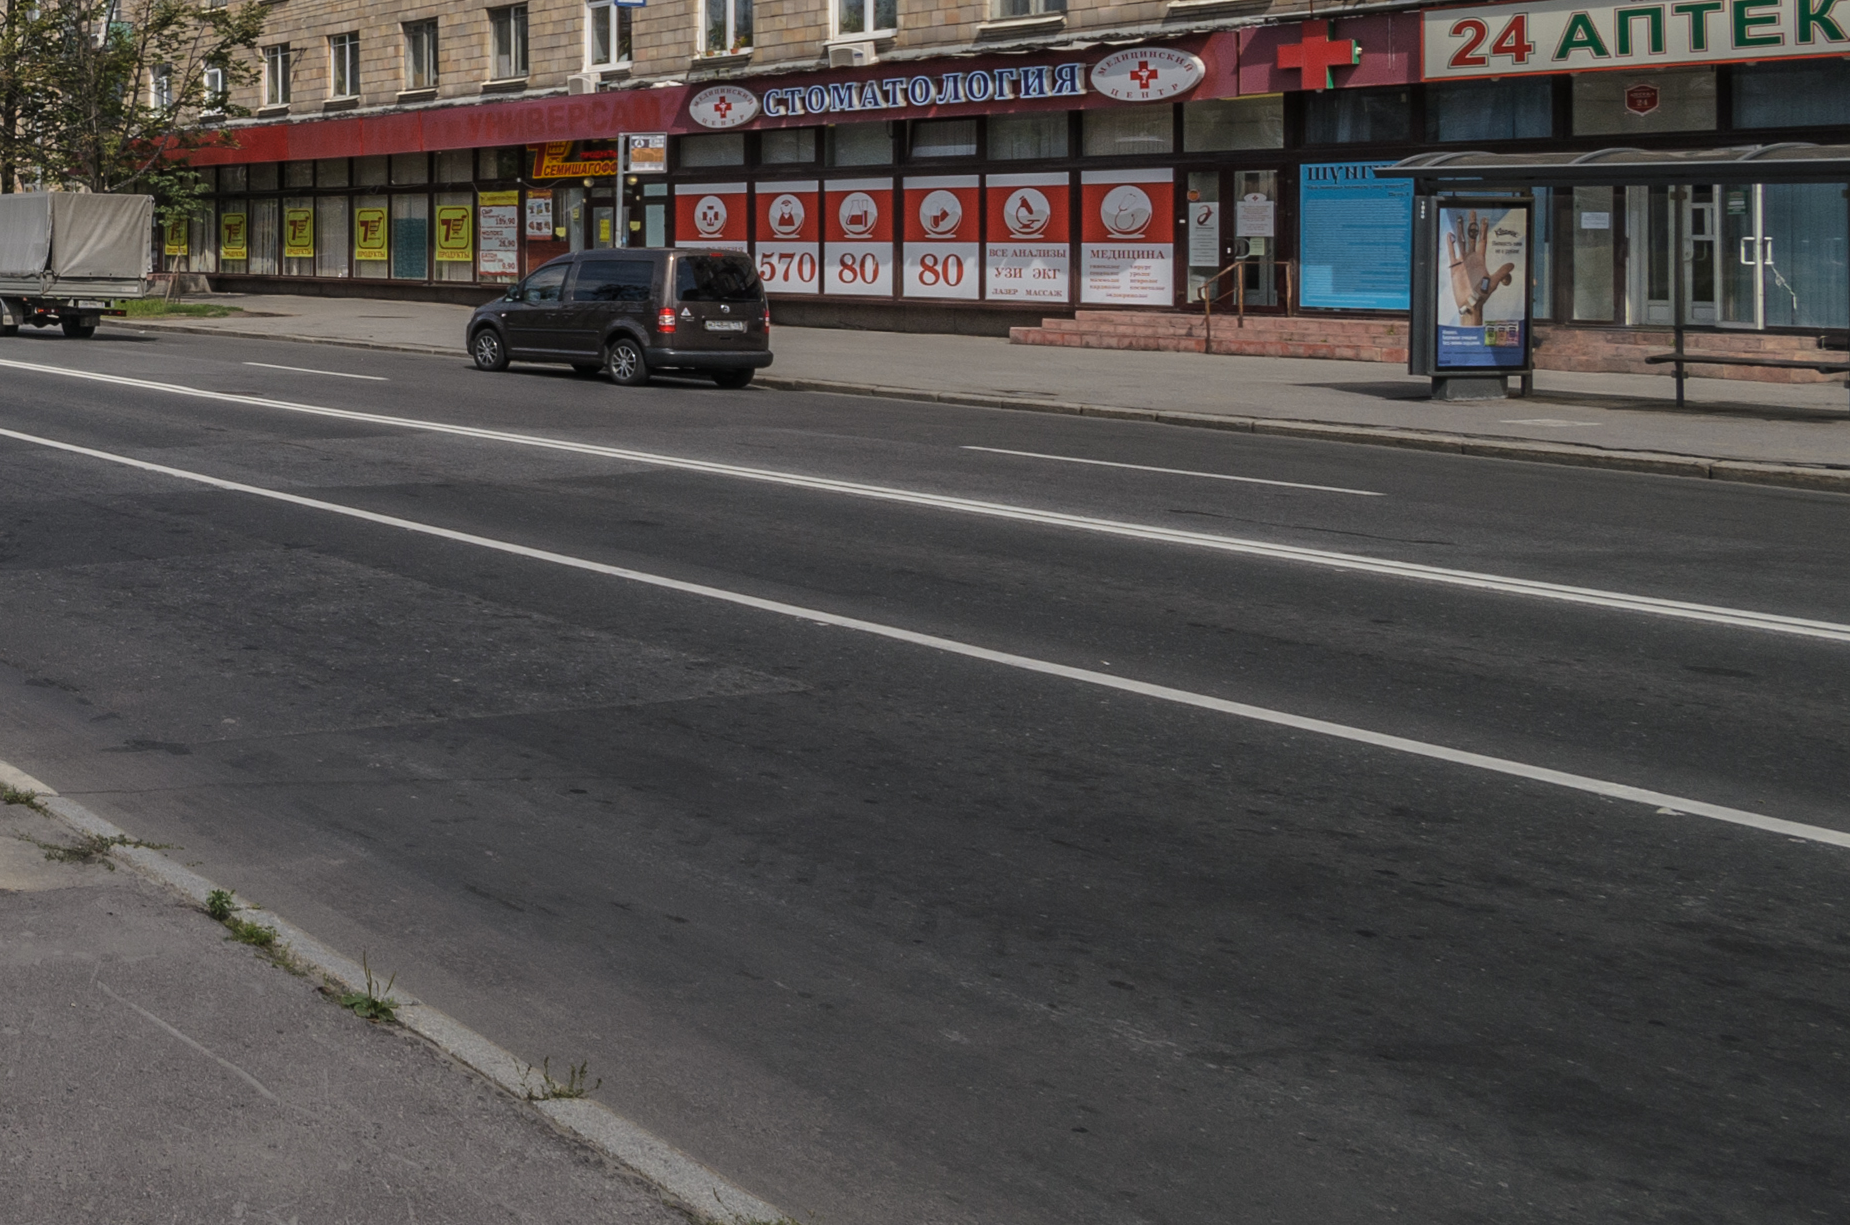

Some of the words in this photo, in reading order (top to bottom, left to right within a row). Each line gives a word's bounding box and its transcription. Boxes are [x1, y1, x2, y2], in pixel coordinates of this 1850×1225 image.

[1447, 12, 1535, 70] 24
[1099, 50, 1194, 76] МЕДИЦИНСКИЙ
[693, 87, 754, 107] МЕДИЦИНСКИЙ
[763, 61, 1083, 117] СТОМАТОЛОГИЯ
[1111, 82, 1180, 99] ЦЕНТР
[467, 93, 661, 141] УНИВЕРСАМ
[701, 114, 745, 126] ЦЕНТР
[989, 248, 1008, 258] ВСЕ
[1011, 248, 1067, 258] АНАЛИЗЫ
[1090, 249, 1165, 260] МЕДИЦИНА
[759, 252, 817, 283] 570
[838, 252, 879, 285] 80
[918, 253, 964, 287] 80
[994, 267, 1023, 279] УЗИ
[1032, 268, 1061, 279] ЭКГ
[992, 288, 1019, 296] ЛАЗЕР
[1025, 289, 1063, 297] МАССАЖ
